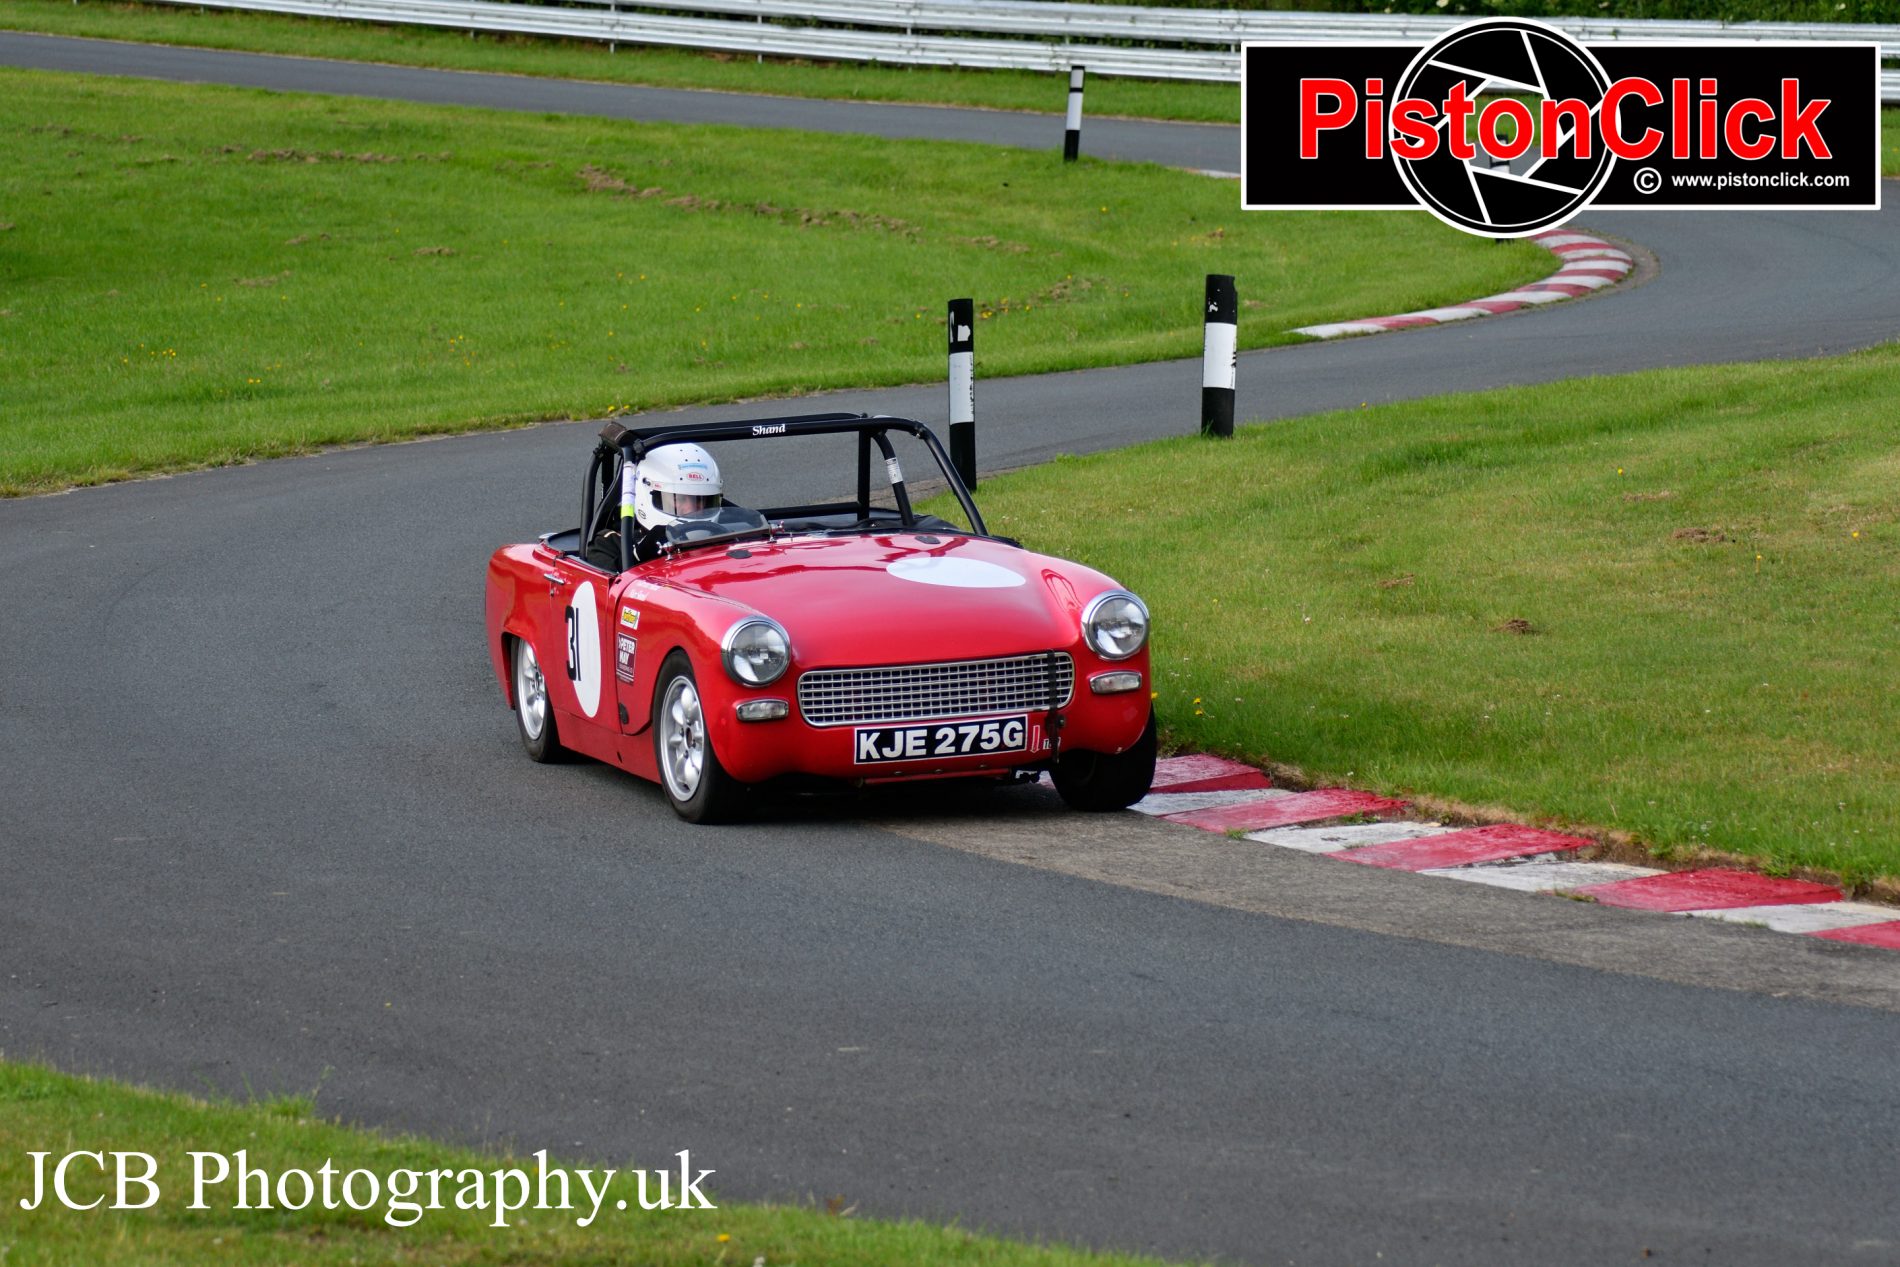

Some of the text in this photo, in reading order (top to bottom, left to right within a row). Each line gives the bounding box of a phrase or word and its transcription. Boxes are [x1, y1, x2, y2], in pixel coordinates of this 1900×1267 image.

[752, 423, 785, 436] Shand
[565, 604, 582, 681] 31
[859, 720, 1024, 760] KJE 275G
